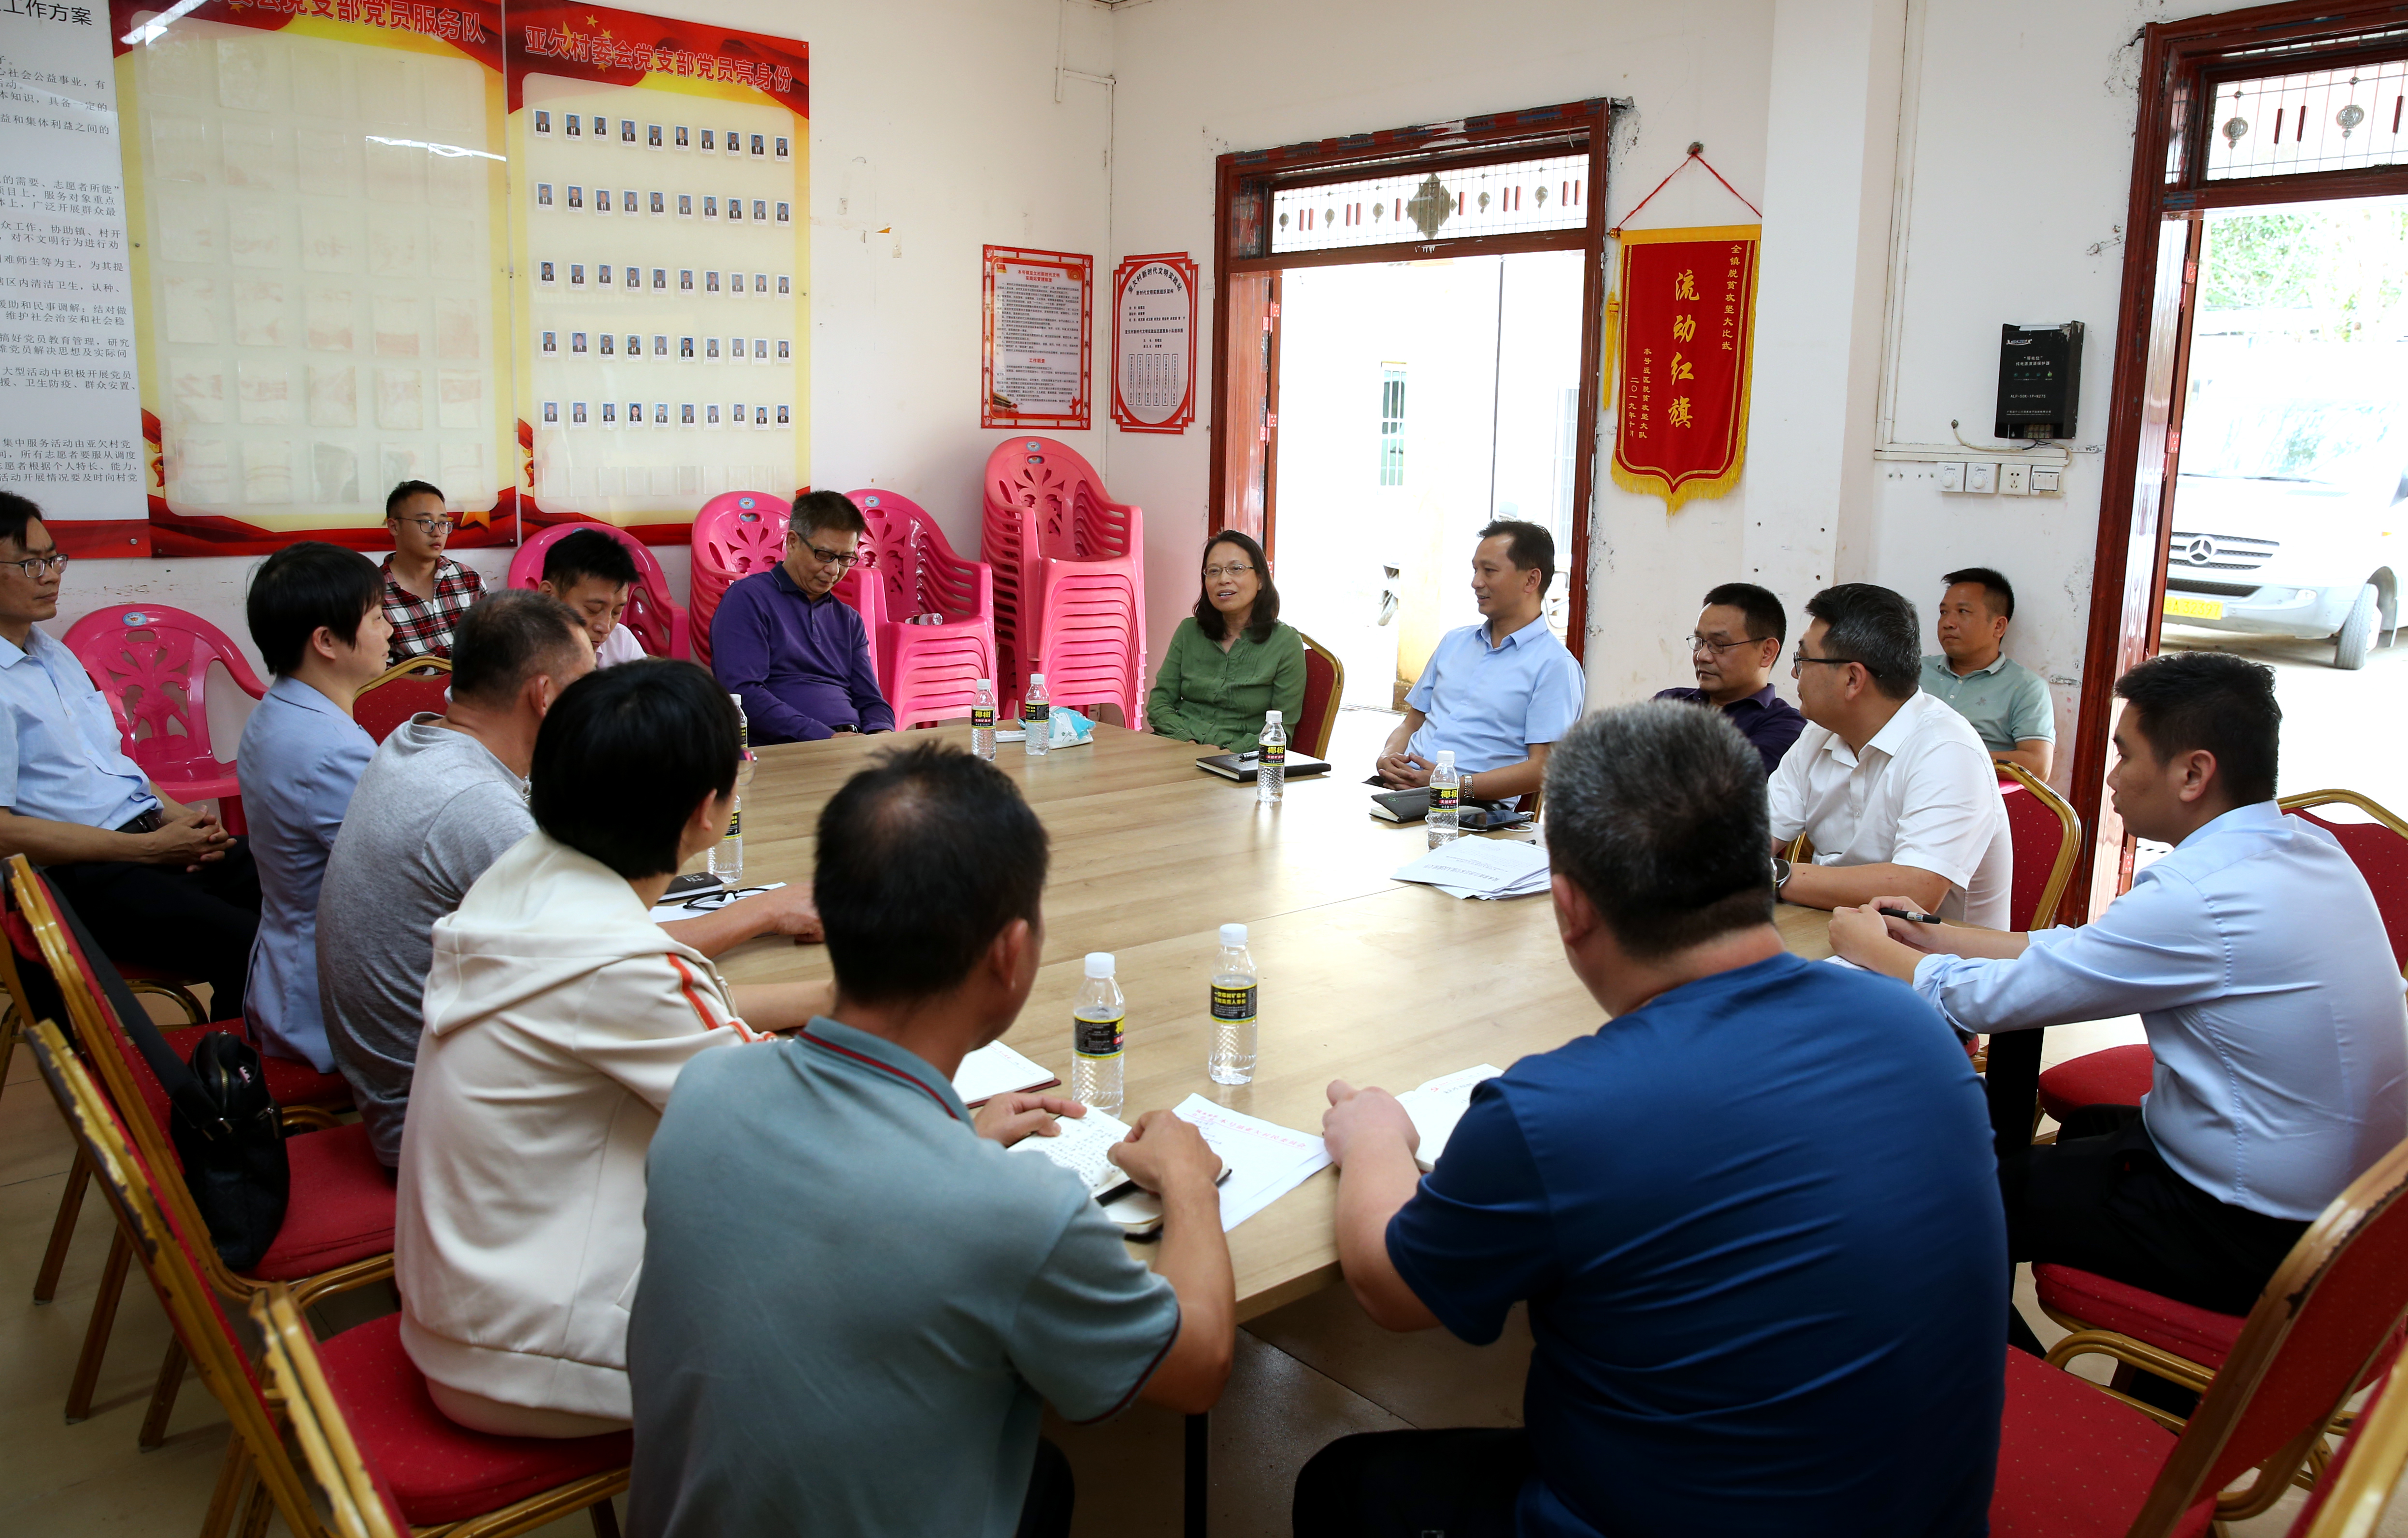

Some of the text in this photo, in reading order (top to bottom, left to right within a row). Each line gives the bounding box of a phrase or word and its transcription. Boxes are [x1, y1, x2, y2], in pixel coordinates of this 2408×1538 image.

[525, 25, 793, 92] 亚欠村委会党支部党员亮身份
[0, 114, 109, 135] 益和集体利益之间的
[1, 220, 121, 239] 众工作，协助镇、村开
[0, 254, 124, 271] 难师生等为主，为其提
[1721, 244, 1743, 351] 全镇脱贫攻坚大比武
[6, 311, 125, 326] 维护社会治安和社会稳
[1668, 269, 1700, 429] 流动红旗
[2, 366, 131, 380] 大型活动中积极开展党员
[3, 438, 131, 449] 集中服务活动由亚欠村党
[0, 462, 137, 471] 愿者根据个人特长、能力，
